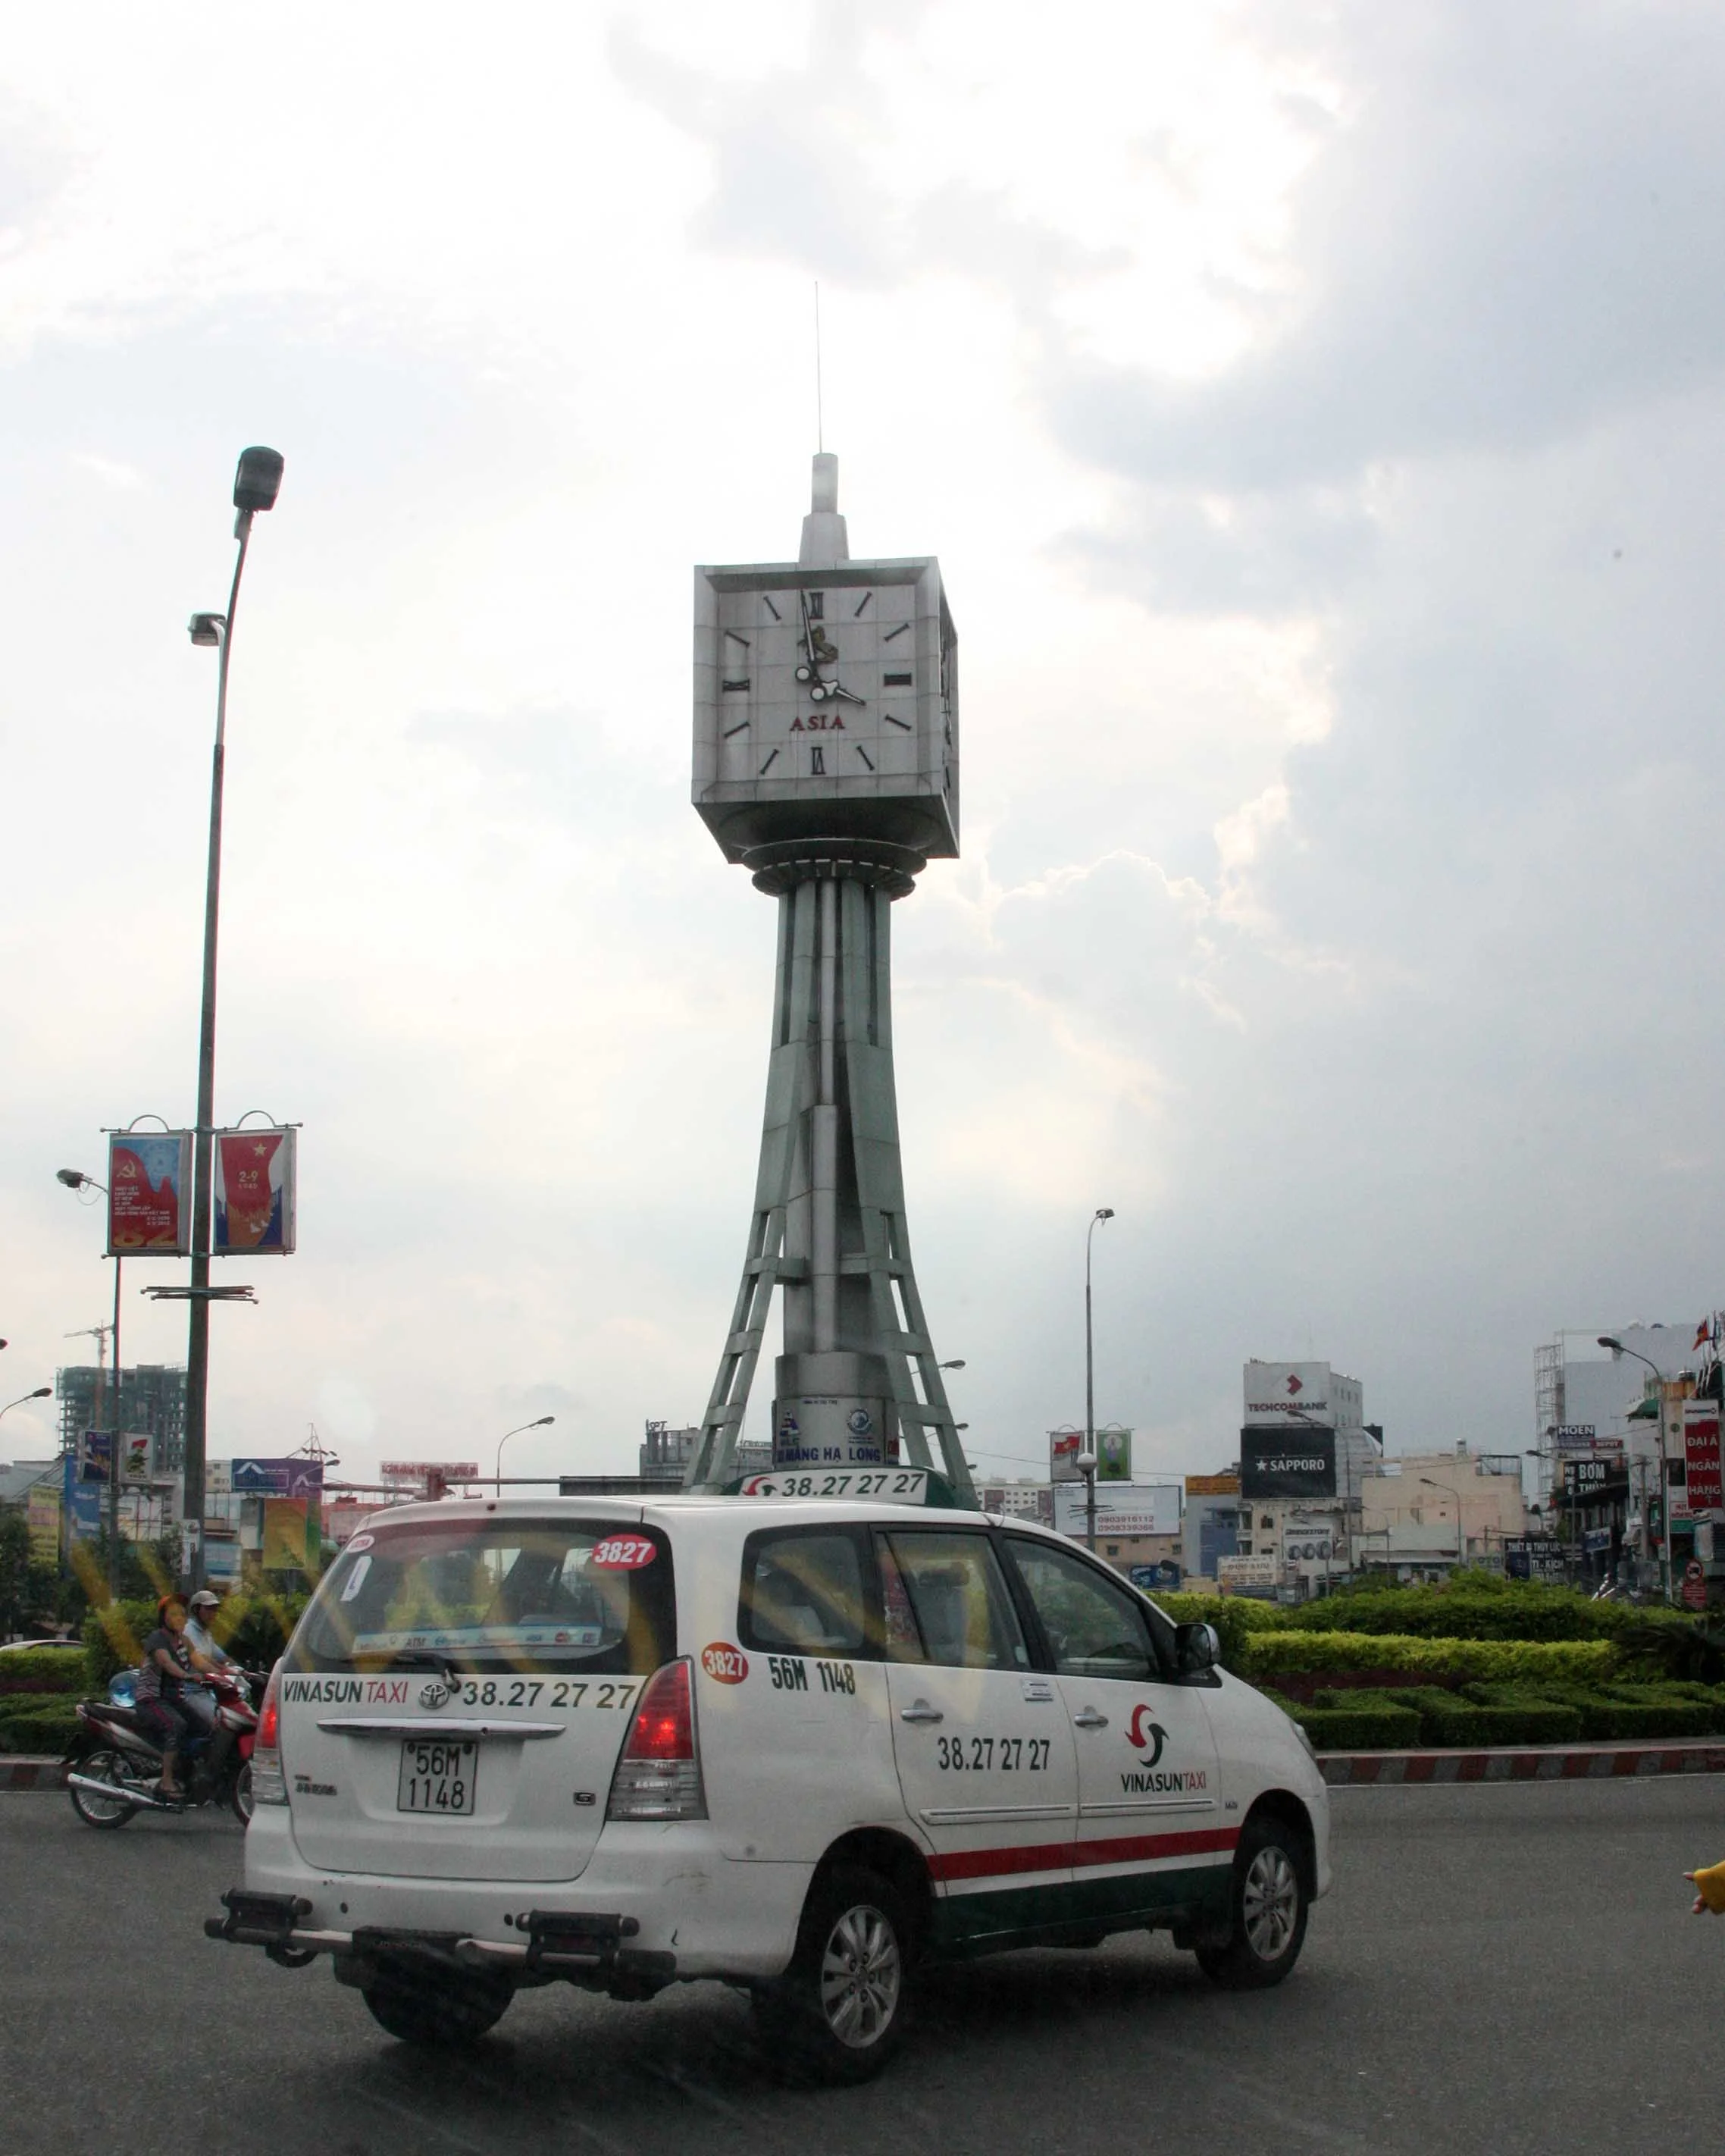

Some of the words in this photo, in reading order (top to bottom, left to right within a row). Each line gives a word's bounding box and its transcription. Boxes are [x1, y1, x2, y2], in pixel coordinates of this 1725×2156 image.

[790, 715, 845, 732] ASIA
[239, 1170, 258, 1183] 2-9
[1248, 1401, 1328, 1412] TECHCOMBANK
[1558, 1426, 1593, 1435] MOEN
[848, 1447, 881, 1462] LONG
[1269, 1459, 1326, 1471] SAPPORO
[1688, 1458, 1720, 1471] NGÂN
[1579, 1462, 1604, 1479] BƠM
[782, 1475, 852, 1497] 38.27
[856, 1474, 888, 1494] 27
[893, 1473, 925, 1493] 27
[594, 1542, 652, 1564] 3827
[703, 1650, 747, 1678] 3827
[769, 1656, 808, 1692] 56M
[818, 1660, 856, 1695] 1148
[284, 1680, 364, 1703] VINASUN
[365, 1681, 409, 1703] TAXI
[463, 1681, 544, 1707] 38.27
[551, 1681, 587, 1708] 27
[596, 1684, 637, 1710] 27
[415, 1745, 460, 1777] 56M
[938, 1737, 994, 1771] 38.27
[1001, 1738, 1022, 1771] 27
[1028, 1738, 1050, 1771] 27
[1121, 1772, 1182, 1793] VINASUN
[1183, 1771, 1207, 1790] TAXI
[409, 1778, 465, 1810] 1148
